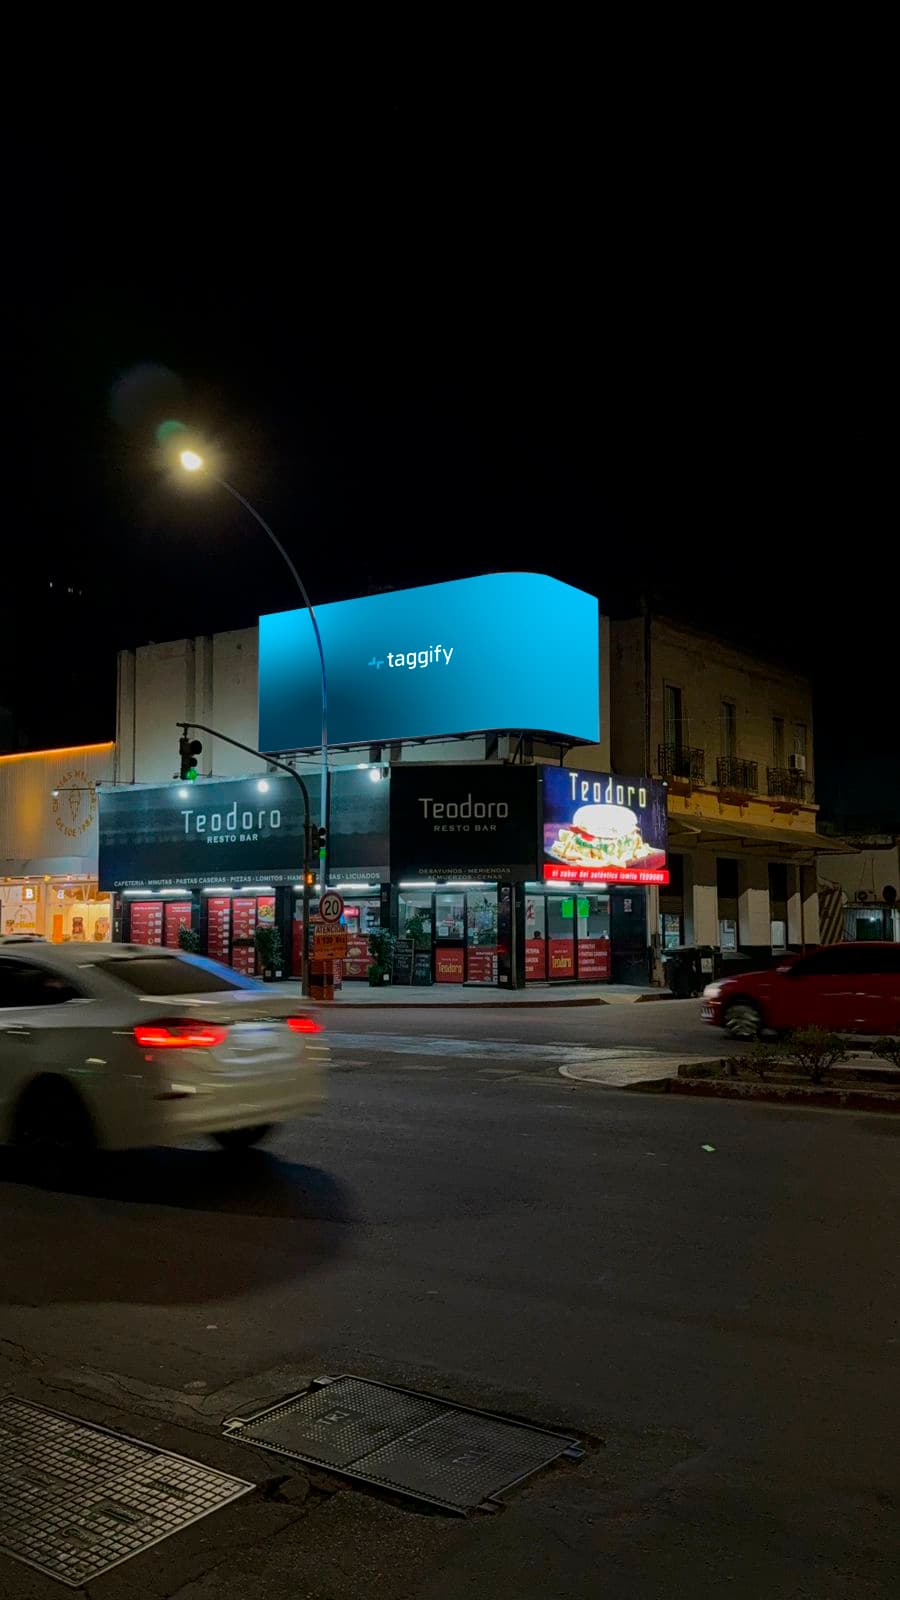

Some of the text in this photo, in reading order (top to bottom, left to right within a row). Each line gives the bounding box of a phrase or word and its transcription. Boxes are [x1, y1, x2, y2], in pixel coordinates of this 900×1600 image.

[387, 644, 454, 670] taggify
[569, 772, 647, 808] Teodoro
[181, 801, 281, 834] Teodoro
[418, 793, 509, 819] Teodoro
[207, 833, 258, 844] RESTO BAR
[433, 824, 497, 832] RESTO BAR
[324, 900, 340, 916] 20
